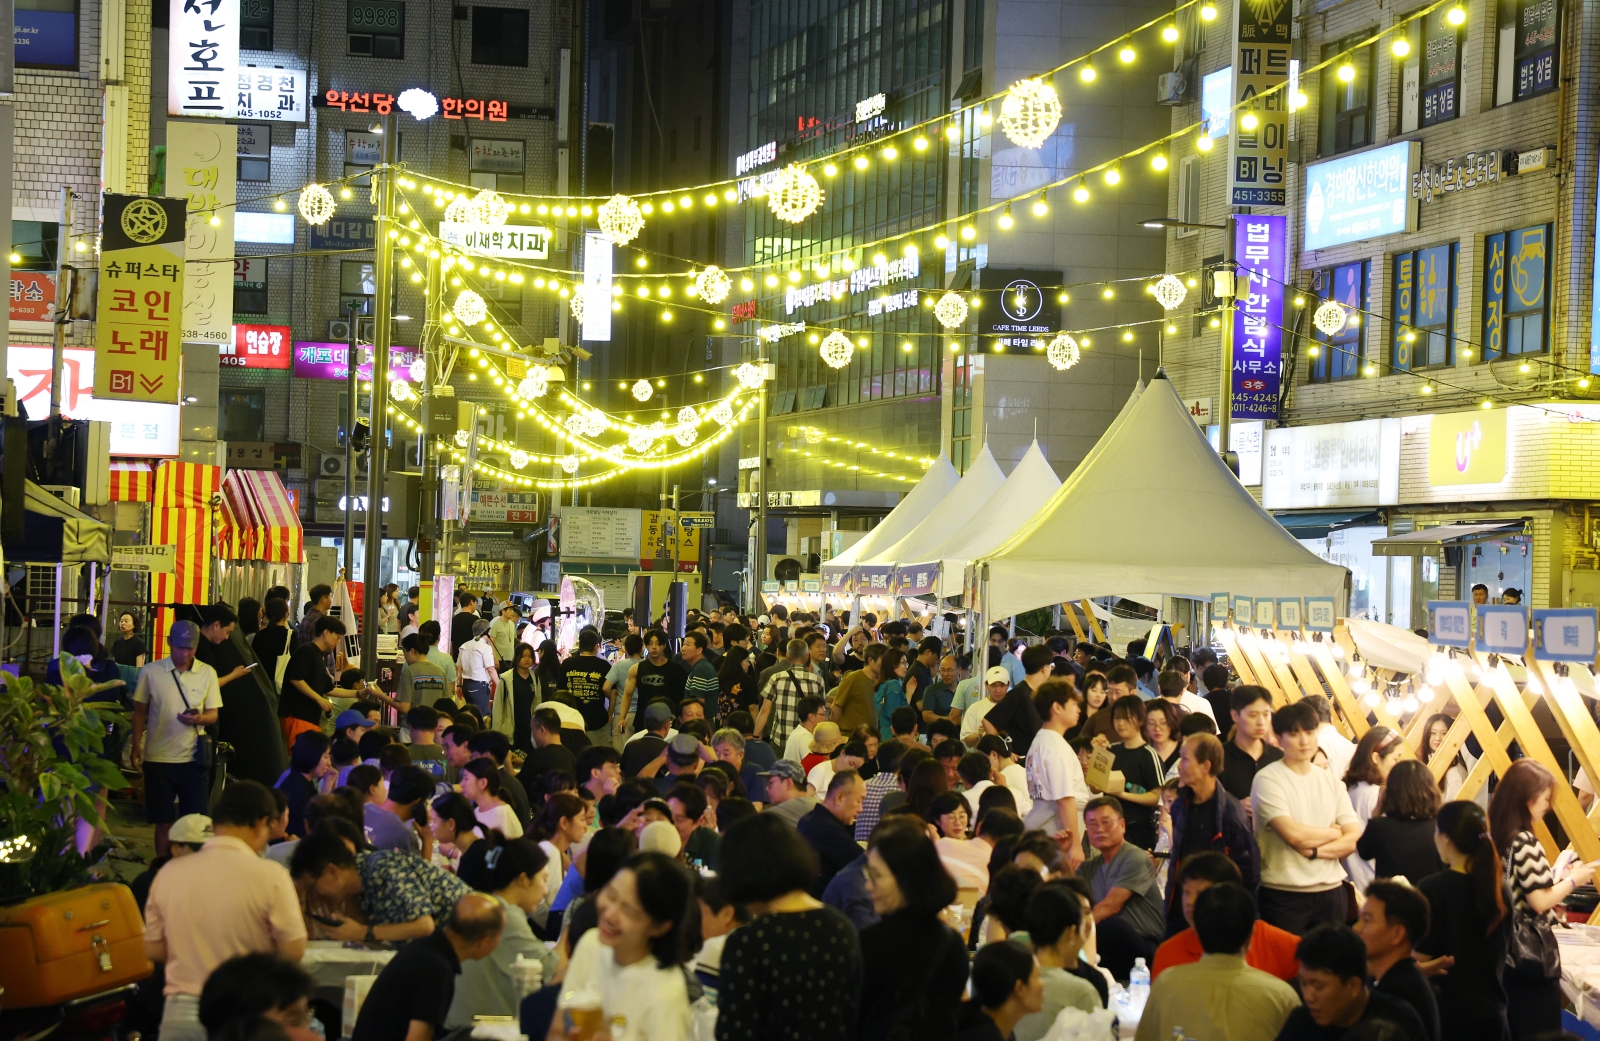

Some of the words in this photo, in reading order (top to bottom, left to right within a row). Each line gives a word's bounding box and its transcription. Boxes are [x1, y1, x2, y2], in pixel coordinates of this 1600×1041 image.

[353, 7, 398, 27] 9988
[1276, 24, 1288, 38] 맥
[1537, 55, 1553, 84] 상담
[325, 89, 394, 115] 약선당
[442, 97, 508, 122] 한의원
[1440, 87, 1454, 114] 상담
[1240, 160, 1256, 179] B1
[1233, 190, 1285, 202] 451-3355
[324, 240, 355, 248] Medical
[465, 230, 504, 252] 이재학
[507, 232, 545, 252] 치과
[105, 260, 180, 283] 슈퍼스타
[109, 289, 172, 322] 코인
[1028, 325, 1050, 333] LEEDS
[107, 330, 170, 361] 노래
[245, 330, 282, 355] 연습장
[1233, 360, 1277, 375] 사무소
[112, 373, 132, 391] B1
[1243, 381, 1264, 390] 3층
[119, 422, 159, 440] 본점
[480, 493, 507, 508] 예쁜수선
